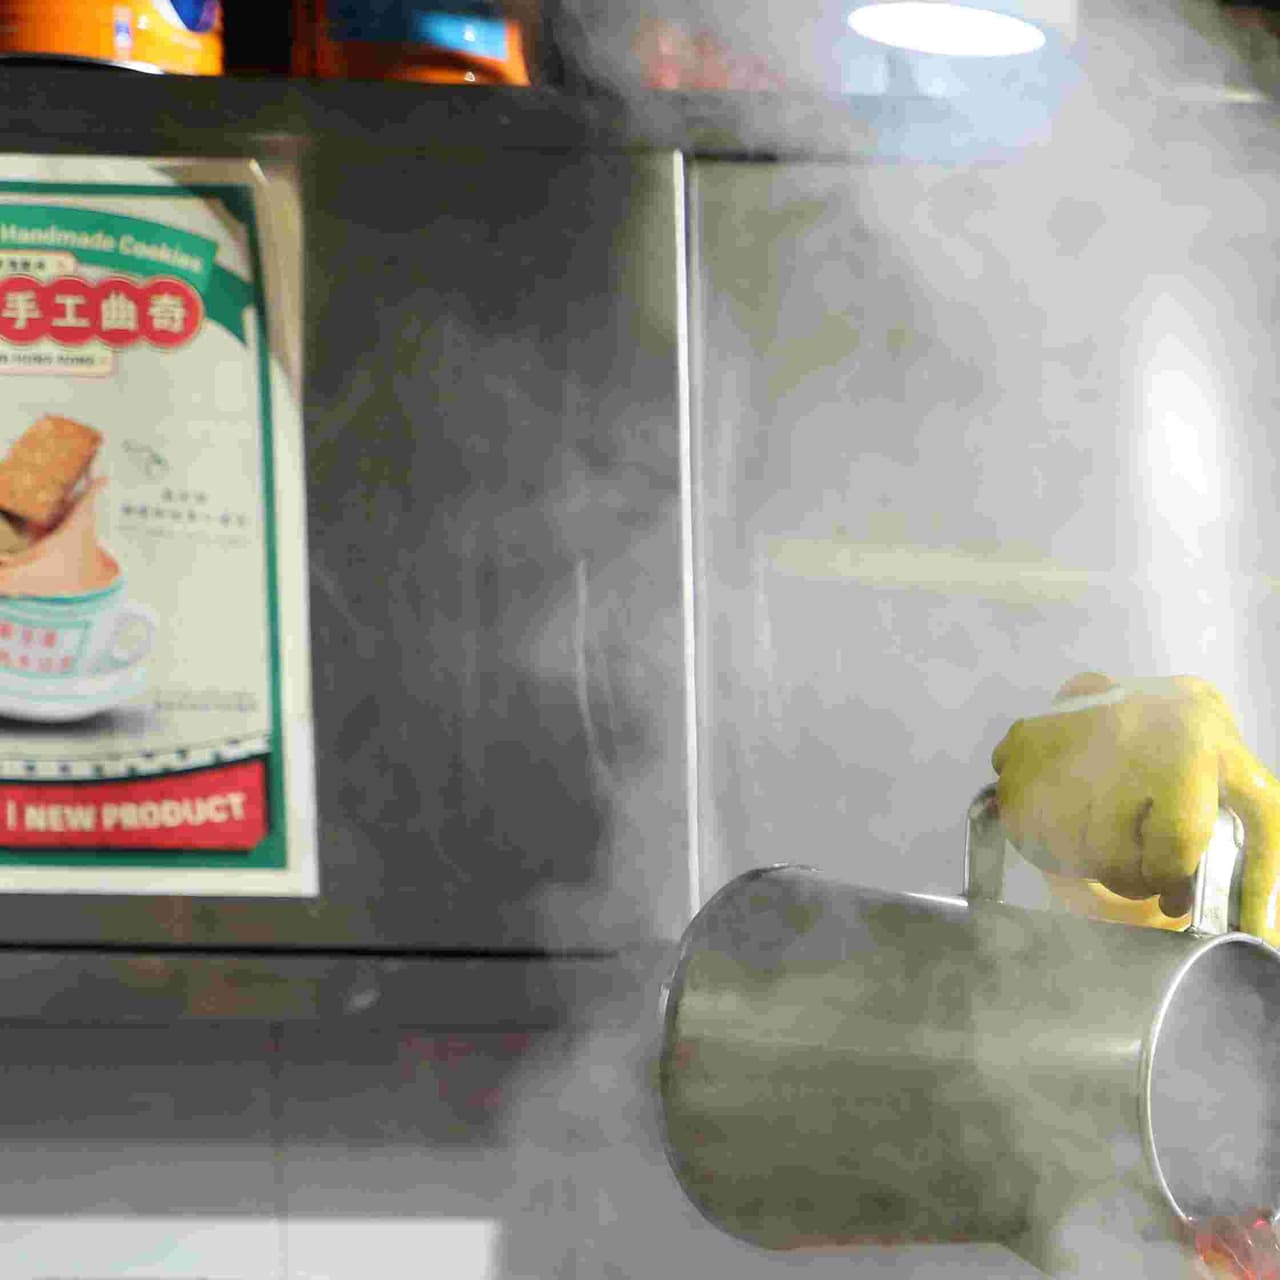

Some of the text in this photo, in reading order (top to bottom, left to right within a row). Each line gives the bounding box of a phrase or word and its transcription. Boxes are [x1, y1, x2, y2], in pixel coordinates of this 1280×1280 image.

[1, 224, 115, 252] Handmade
[1, 290, 190, 333] 手工曲奇
[25, 792, 247, 832] NEW PRODUCT
